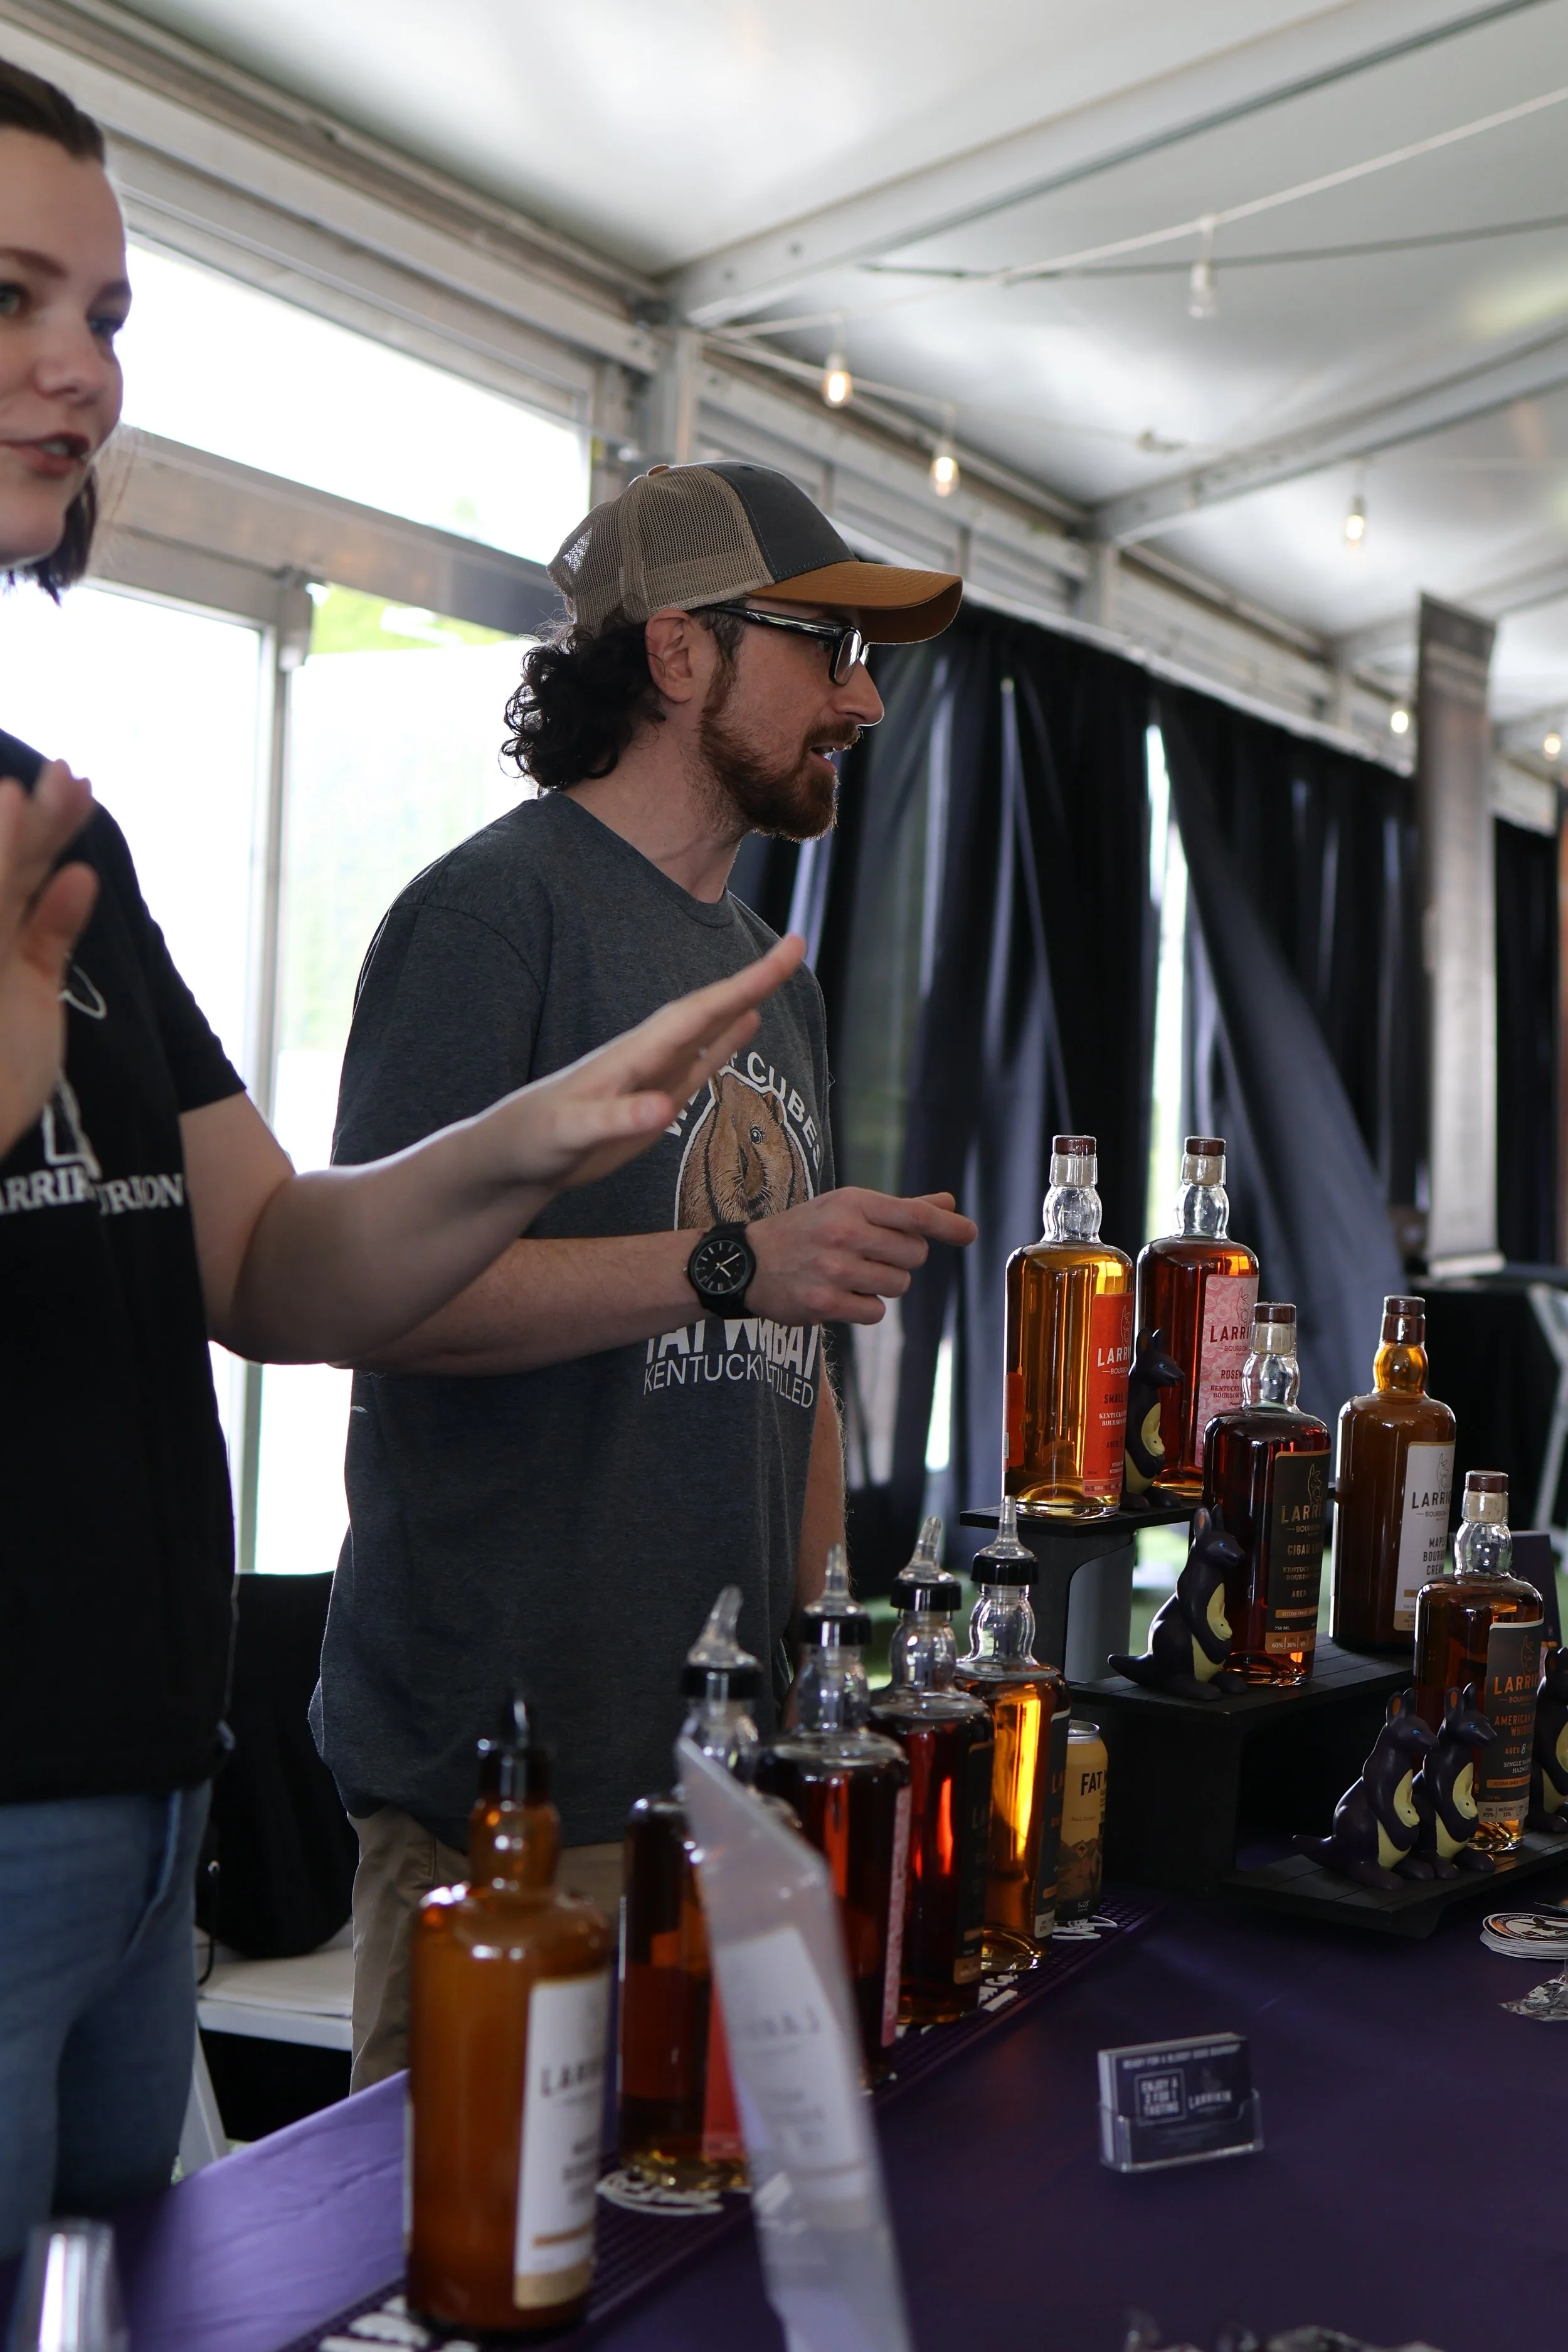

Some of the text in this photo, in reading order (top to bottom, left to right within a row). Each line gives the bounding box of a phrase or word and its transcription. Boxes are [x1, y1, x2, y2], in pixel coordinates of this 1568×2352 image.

[747, 1051, 820, 1171] CUBES
[1104, 1393, 1123, 1404] SMALL
[1102, 1419, 1123, 1427] BOURBON
[1287, 1544, 1310, 1555] CIGAR
[1521, 1744, 1527, 1754] 8
[1081, 1771, 1102, 1796] FAT
